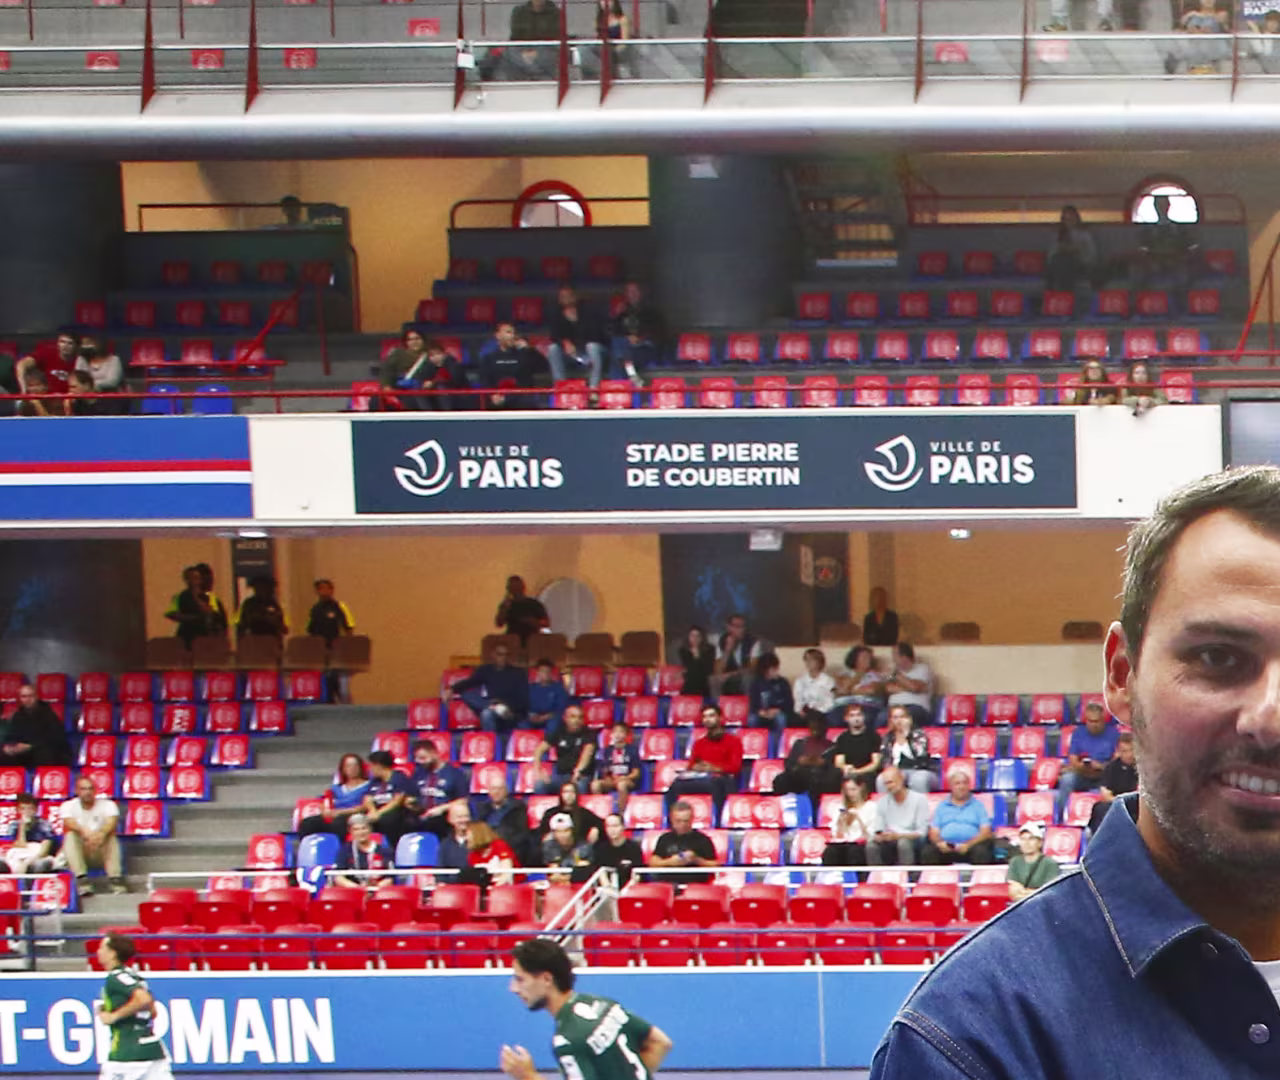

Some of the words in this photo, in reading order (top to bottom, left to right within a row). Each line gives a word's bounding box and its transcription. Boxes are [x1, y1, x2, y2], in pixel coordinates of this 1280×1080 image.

[458, 445, 503, 457] VILLE
[508, 445, 529, 457] DE
[627, 443, 706, 463] STADE
[711, 443, 799, 463] PIERRE
[929, 441, 974, 453] VILLE
[980, 441, 1001, 453] DE
[458, 459, 564, 488] PARIS
[627, 467, 660, 487] DE
[664, 467, 801, 487] COUBERTIN
[930, 455, 1035, 484] PARIS
